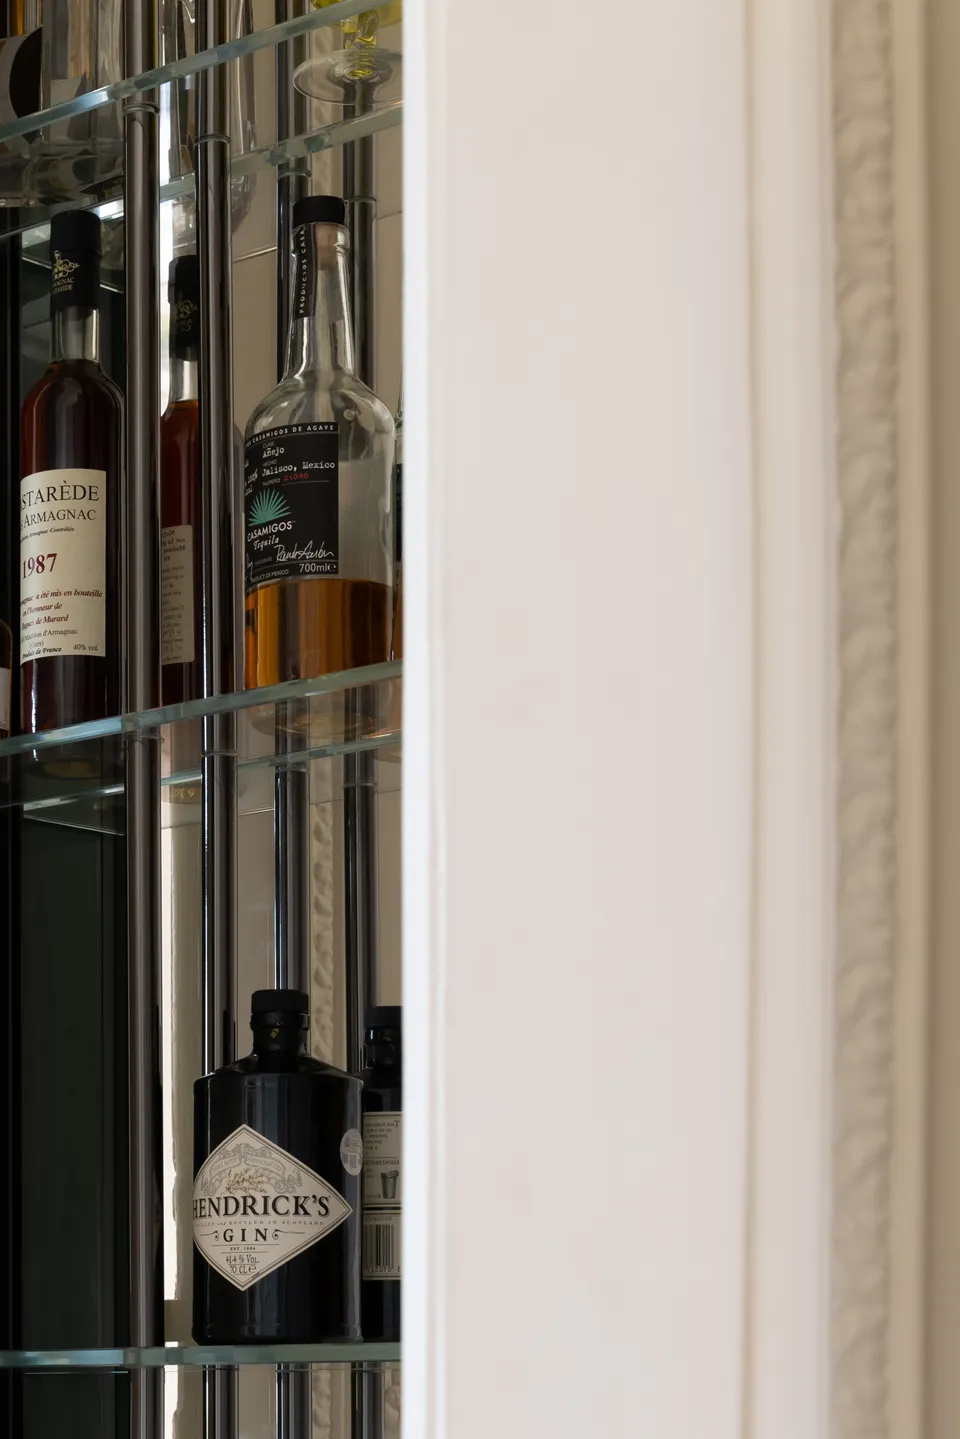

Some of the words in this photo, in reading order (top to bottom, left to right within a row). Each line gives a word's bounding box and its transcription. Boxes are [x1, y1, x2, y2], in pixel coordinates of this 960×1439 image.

[252, 427, 289, 443] CASAMIGOS
[262, 447, 285, 459] Añejo
[261, 464, 297, 477] Jalisco,
[302, 461, 336, 470] Mexico
[20, 479, 100, 511] STARÈDE
[23, 508, 97, 530] ARMAGNAC
[246, 520, 293, 542] CASAMIGOS
[253, 534, 280, 551] Tequila
[22, 552, 58, 580] 1987
[50, 589, 62, 598] mis
[73, 588, 103, 598] bouteille
[192, 1194, 330, 1220] HENDRICK'S
[223, 1228, 269, 1242] GIN
